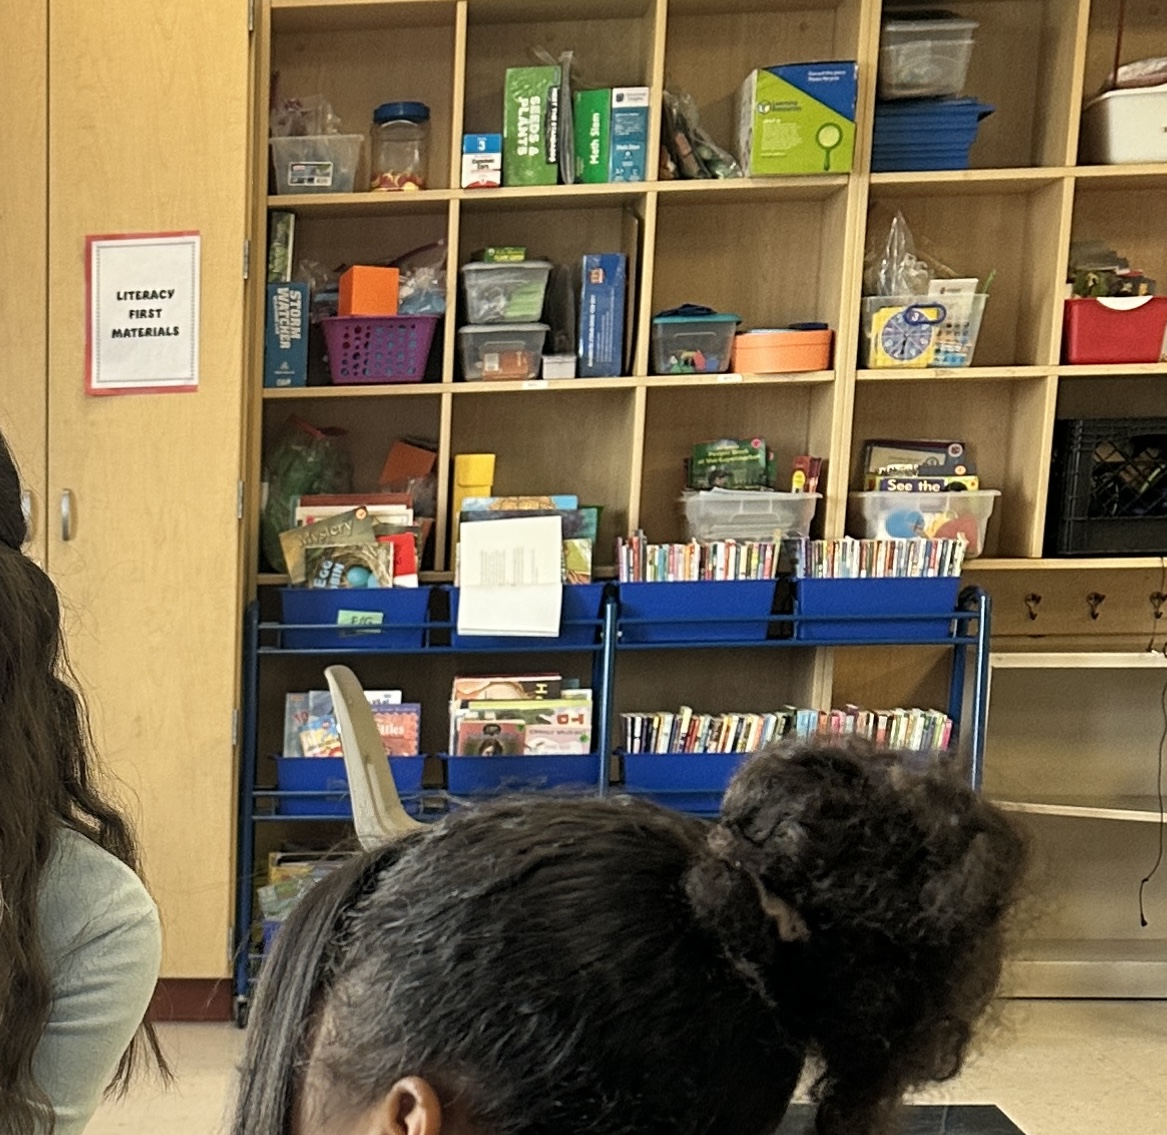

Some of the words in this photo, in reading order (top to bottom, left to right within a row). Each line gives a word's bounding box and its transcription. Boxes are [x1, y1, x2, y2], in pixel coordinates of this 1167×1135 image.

[517, 97, 529, 156] PLANTS
[529, 96, 541, 143] SEEDS
[590, 112, 601, 137] Slam
[589, 138, 600, 165] Math
[116, 288, 176, 301] LITERACY
[129, 308, 163, 320] FIRST
[277, 287, 291, 349] WATCHER
[290, 289, 302, 339] STORM
[111, 326, 180, 339] MATERIALS
[887, 479, 912, 492] See
[918, 481, 940, 492] the
[313, 560, 332, 588] EGG
